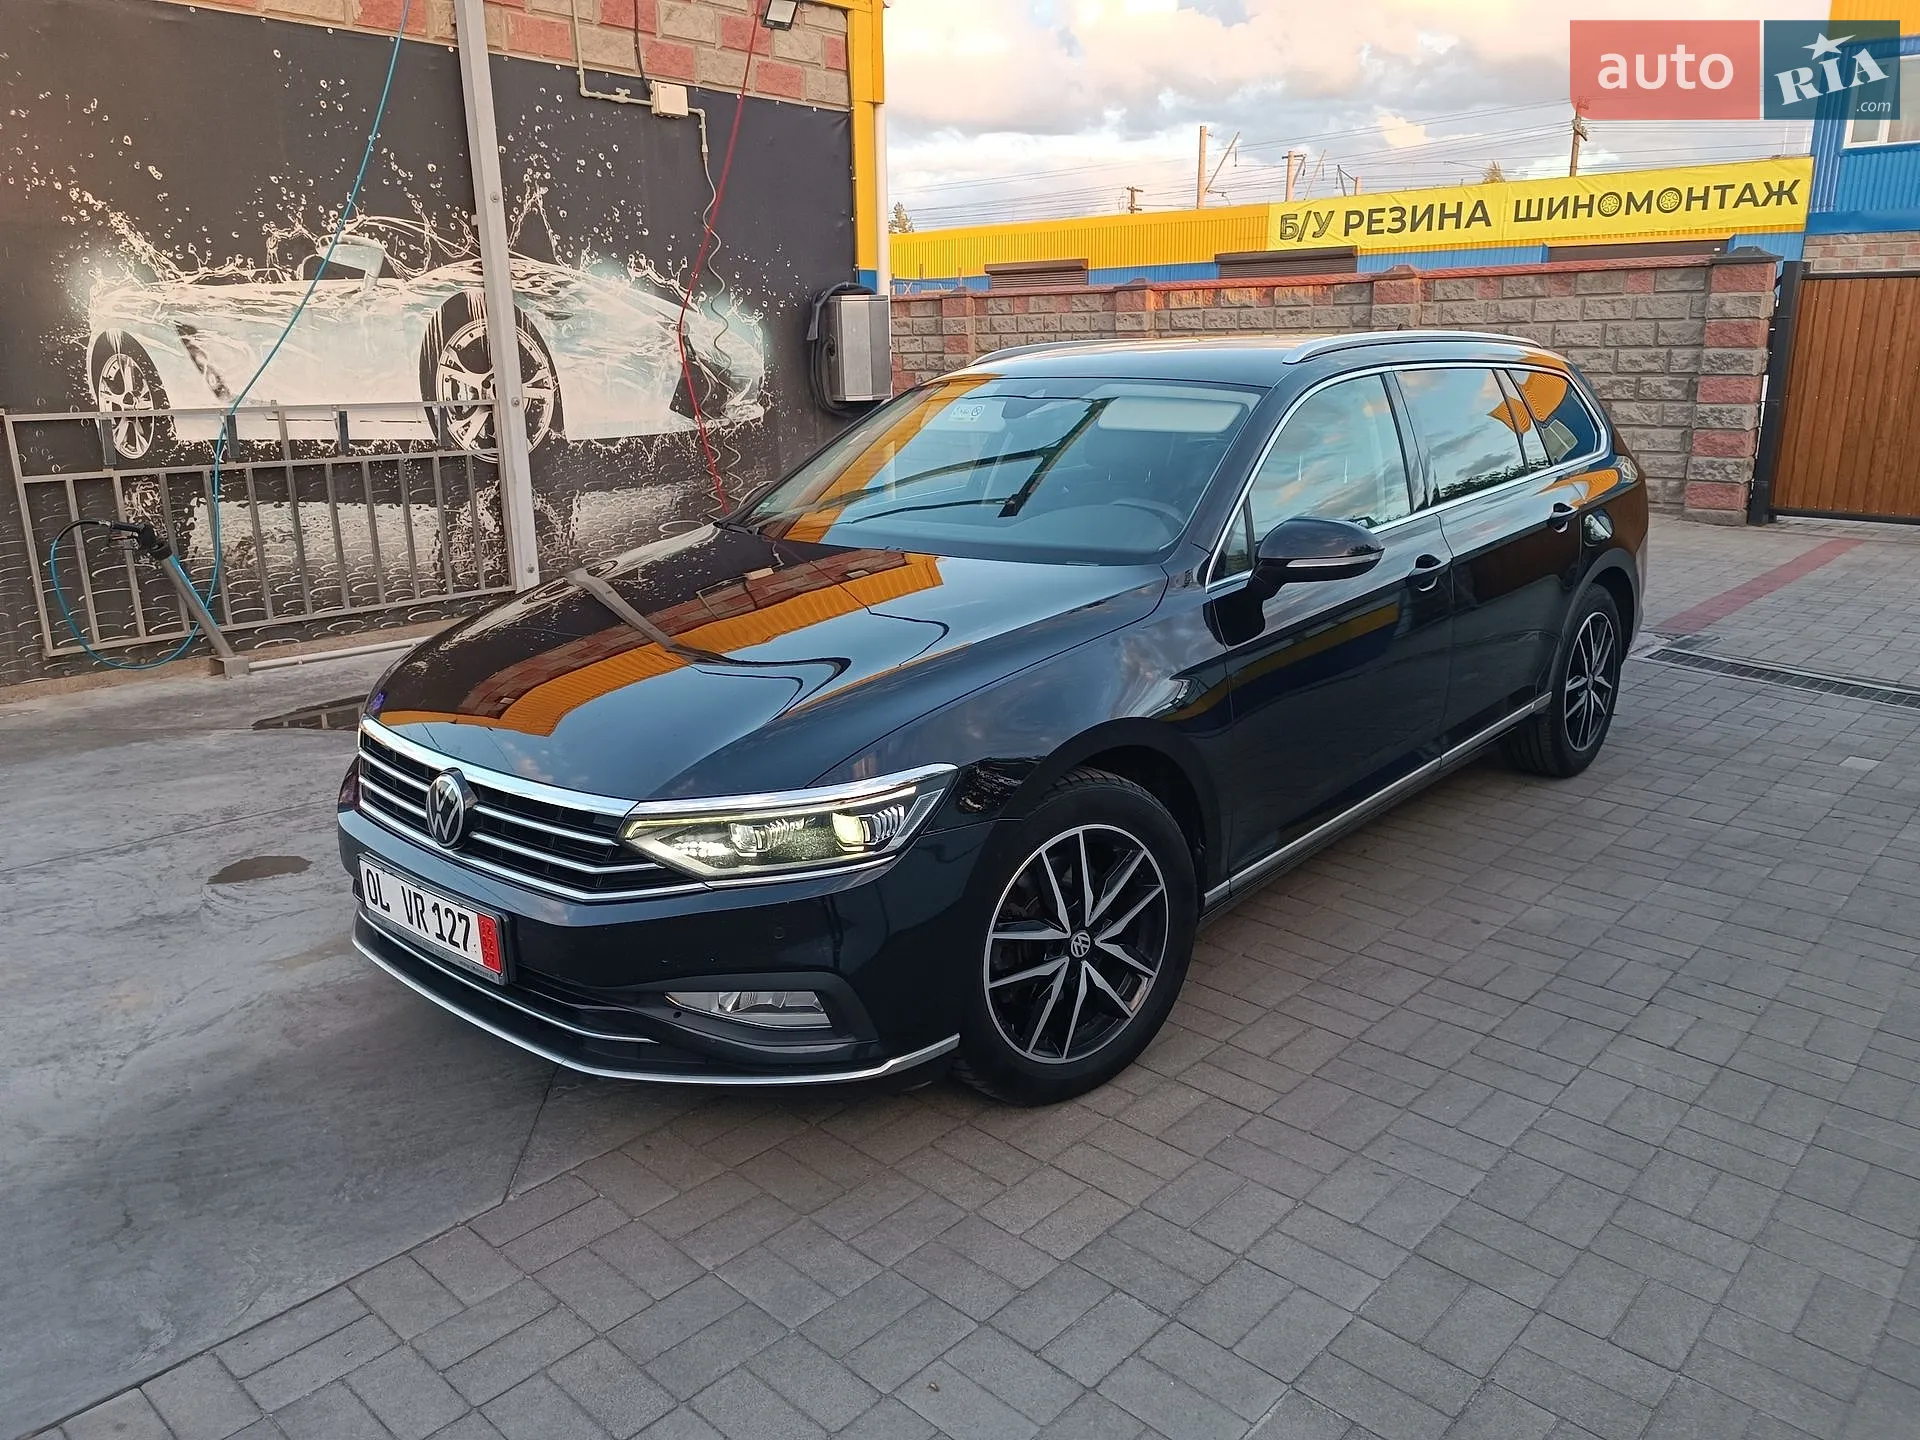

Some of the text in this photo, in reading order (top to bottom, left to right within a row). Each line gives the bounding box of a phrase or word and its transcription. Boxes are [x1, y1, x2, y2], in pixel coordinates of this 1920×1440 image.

[1279, 178, 1802, 243] Б/У РЕЗИНА ШИНОМОНТАЖ
[366, 868, 471, 953] OL VR 127
